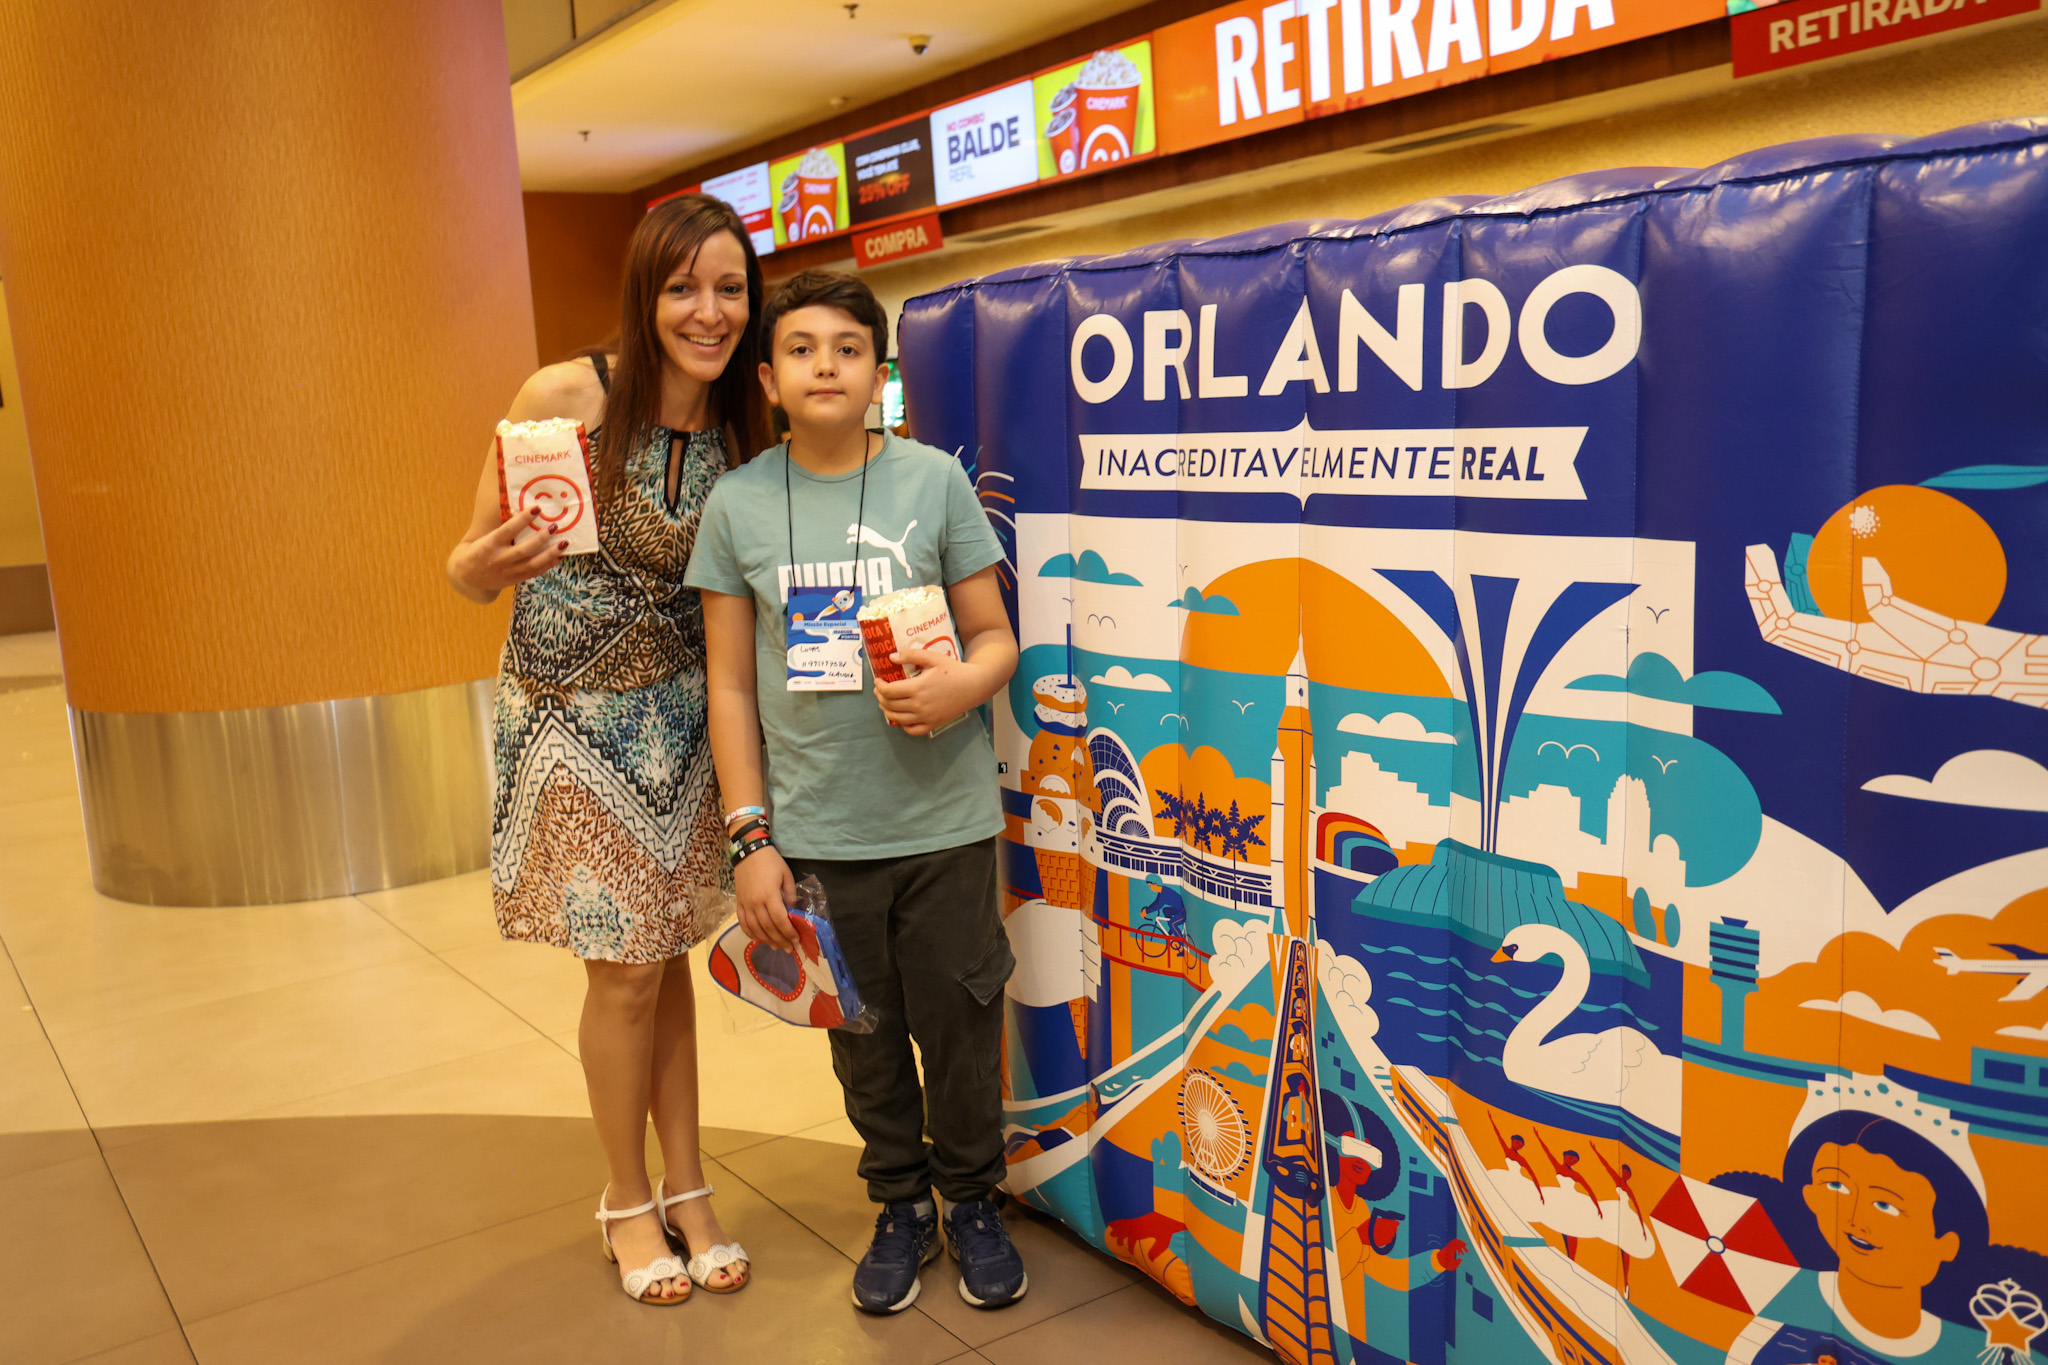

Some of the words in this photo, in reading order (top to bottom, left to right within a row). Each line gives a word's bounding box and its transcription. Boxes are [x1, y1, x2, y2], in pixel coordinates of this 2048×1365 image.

[1769, 0, 1988, 54] RETIRAD
[948, 116, 1021, 165] BALDE
[865, 225, 929, 259] COMPRA
[1071, 264, 1642, 404] ORLANDO
[514, 450, 572, 464] CINEMARK
[777, 556, 894, 604] PUMA
[905, 610, 949, 637] CINEMARK
